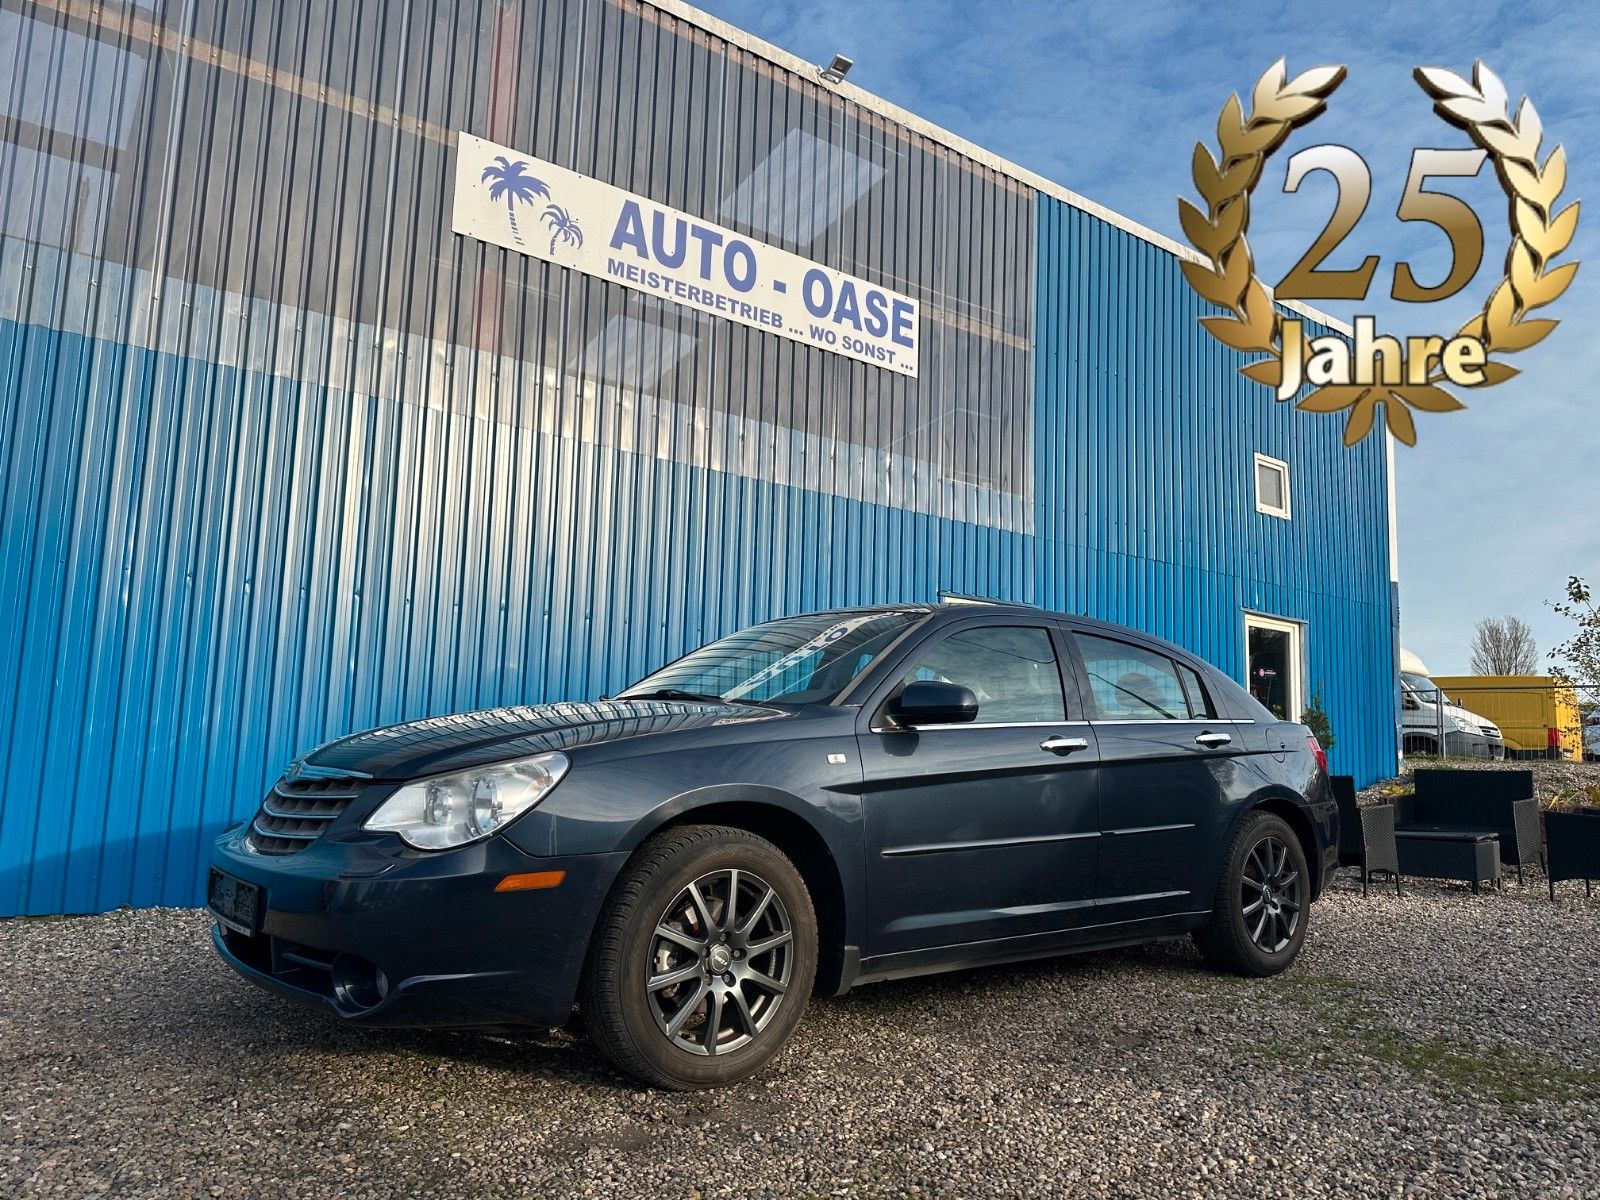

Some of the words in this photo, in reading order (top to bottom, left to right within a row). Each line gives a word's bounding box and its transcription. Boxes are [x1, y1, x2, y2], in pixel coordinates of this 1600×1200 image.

[606, 257, 783, 329] MEISTERBETRIEB
[809, 325, 837, 346] WO
[841, 335, 897, 365] SONST
[609, 199, 757, 293] AUTO
[801, 267, 915, 349] OASE
